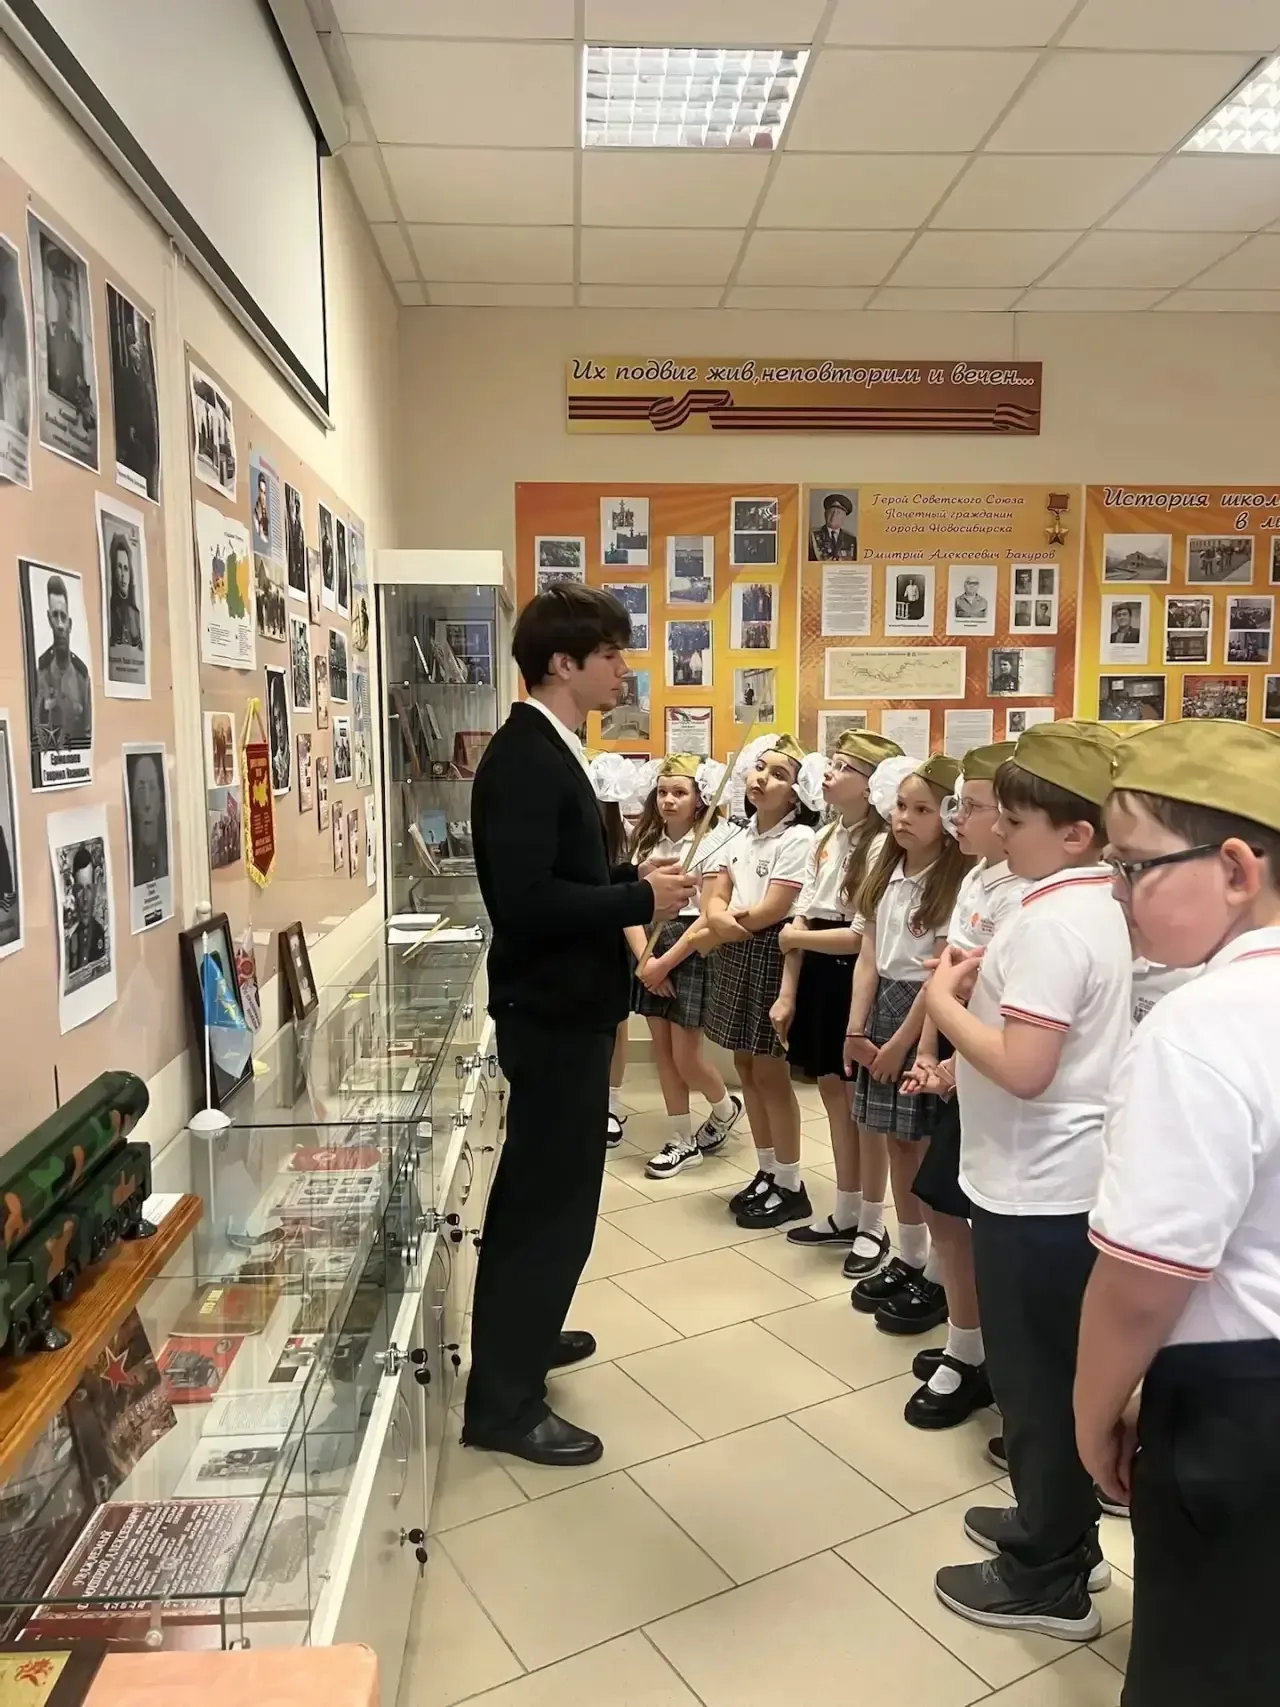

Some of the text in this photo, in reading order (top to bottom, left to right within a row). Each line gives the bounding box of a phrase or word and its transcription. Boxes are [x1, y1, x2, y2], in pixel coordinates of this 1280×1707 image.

[572, 358, 606, 381] Их
[614, 359, 697, 381] подвиг
[927, 367, 946, 384] и
[950, 361, 1035, 386] вечен...
[872, 494, 1024, 505] Герой Советского Союза
[1103, 486, 1210, 512] История
[950, 509, 1013, 520] гражданин
[1234, 511, 1250, 531] в
[885, 523, 1013, 534] города Новосибирска
[863, 548, 1056, 562] Дмитрий Алексеевич Бакуров
